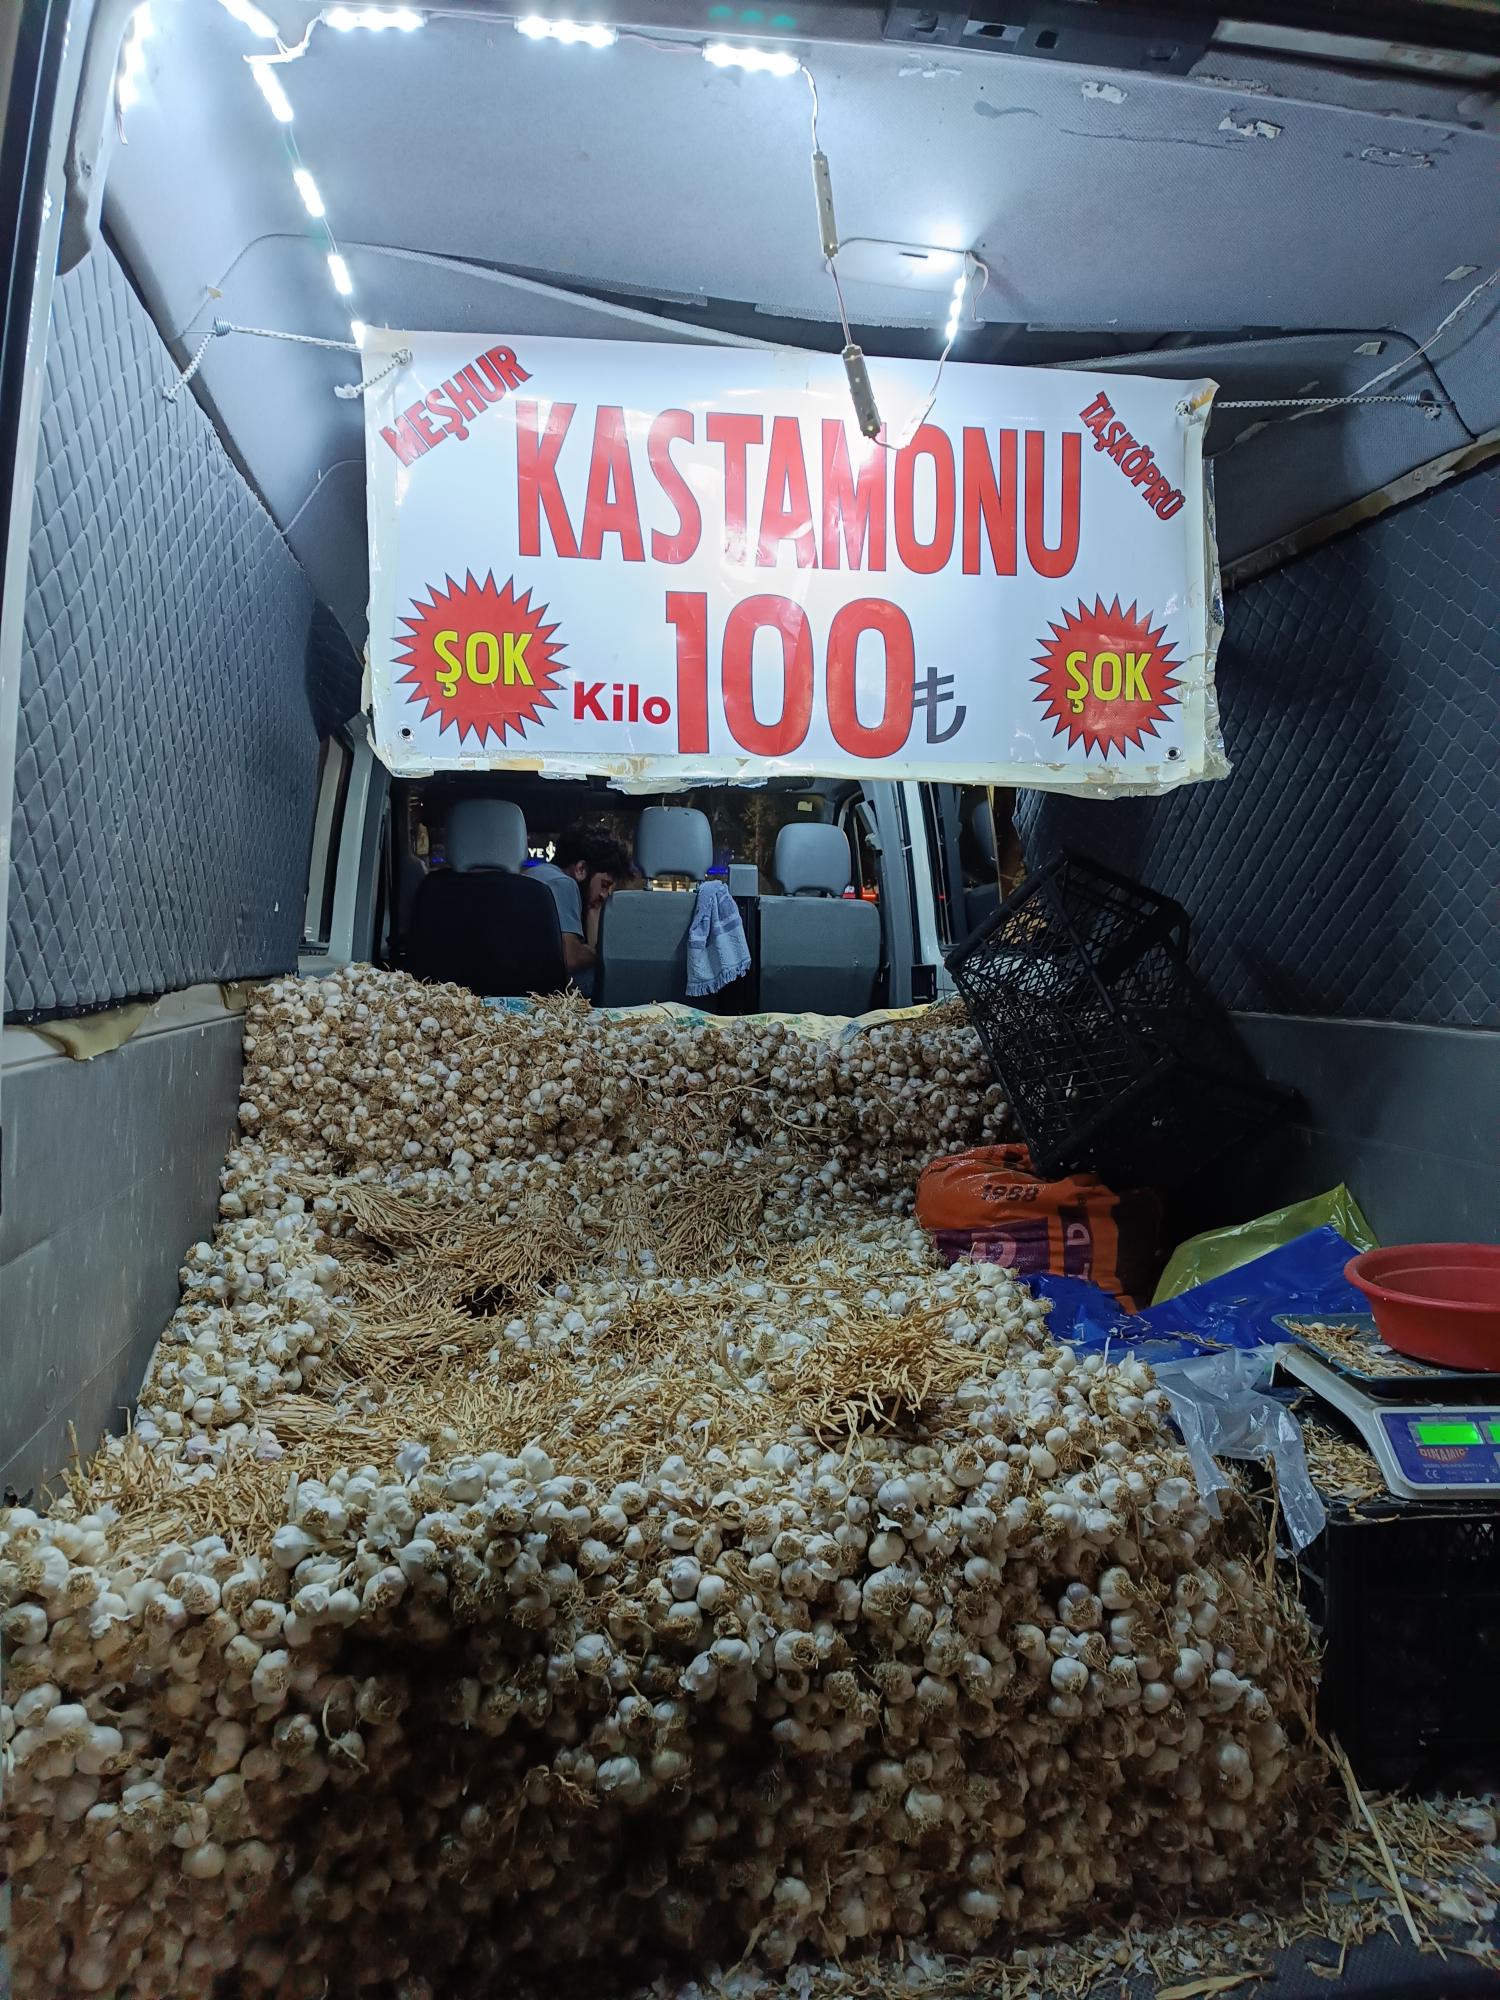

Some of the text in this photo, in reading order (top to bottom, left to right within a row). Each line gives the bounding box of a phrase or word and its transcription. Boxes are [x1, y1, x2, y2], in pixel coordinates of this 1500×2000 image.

[380, 345, 534, 467] MEŞHUR
[516, 400, 1082, 578] KASTAMONU
[1079, 391, 1185, 521] TAŞKÖPRÜ
[433, 631, 535, 698] ŞOK
[573, 681, 671, 724] Kilo
[1065, 651, 1153, 714] ŞOK
